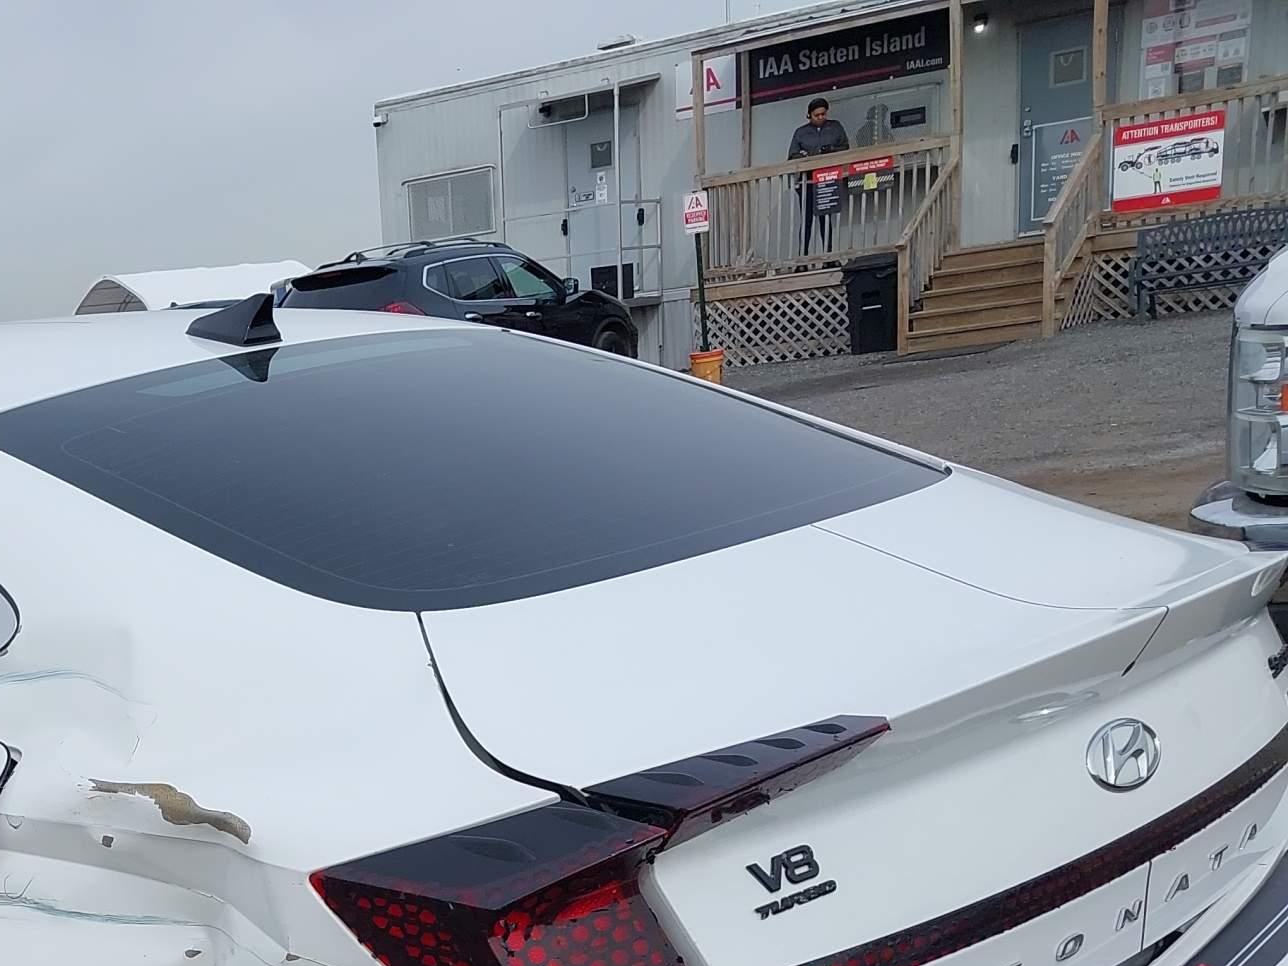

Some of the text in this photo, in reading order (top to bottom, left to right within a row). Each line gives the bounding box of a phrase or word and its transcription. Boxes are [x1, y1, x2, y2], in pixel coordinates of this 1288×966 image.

[759, 26, 926, 79] IAA Staten Island
[1122, 116, 1218, 141] ATTENTION TRANSPORTERS!
[746, 845, 819, 893] V8
